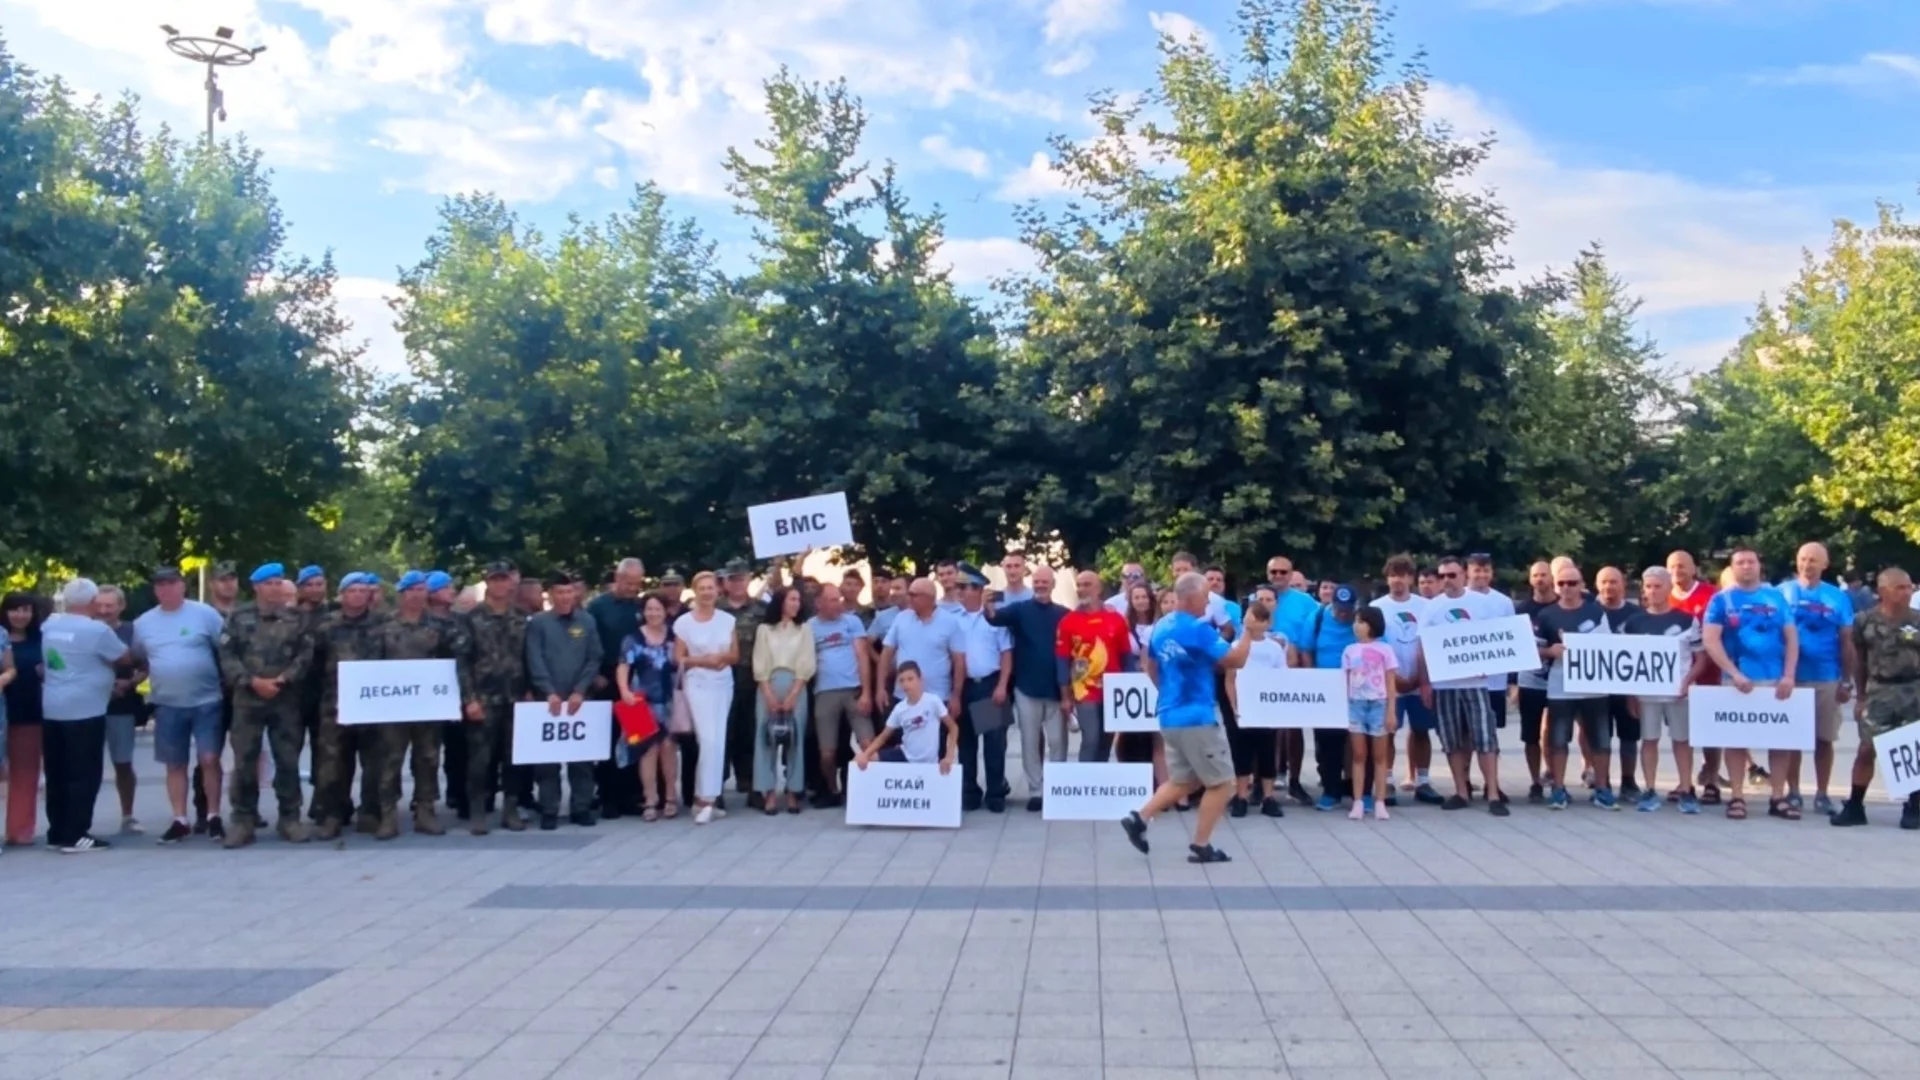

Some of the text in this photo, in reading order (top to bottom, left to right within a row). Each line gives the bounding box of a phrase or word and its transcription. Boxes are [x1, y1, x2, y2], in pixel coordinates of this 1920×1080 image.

[775, 513, 827, 537] ВМС
[1442, 630, 1515, 649] АЕРОКЛУБ
[1447, 647, 1517, 665] МОНТАНА
[1566, 648, 1678, 683] HUNGARY
[359, 684, 449, 700] ДЕСАНТ 68
[1259, 691, 1326, 704] ROMANIA
[1113, 687, 1158, 719] POL
[1714, 711, 1790, 724] MOLDOVA
[541, 721, 587, 742] ВВС
[884, 776, 925, 791] СКАЙ
[1051, 785, 1147, 797] MONTENEGRO
[877, 797, 931, 810] ШУМЕН
